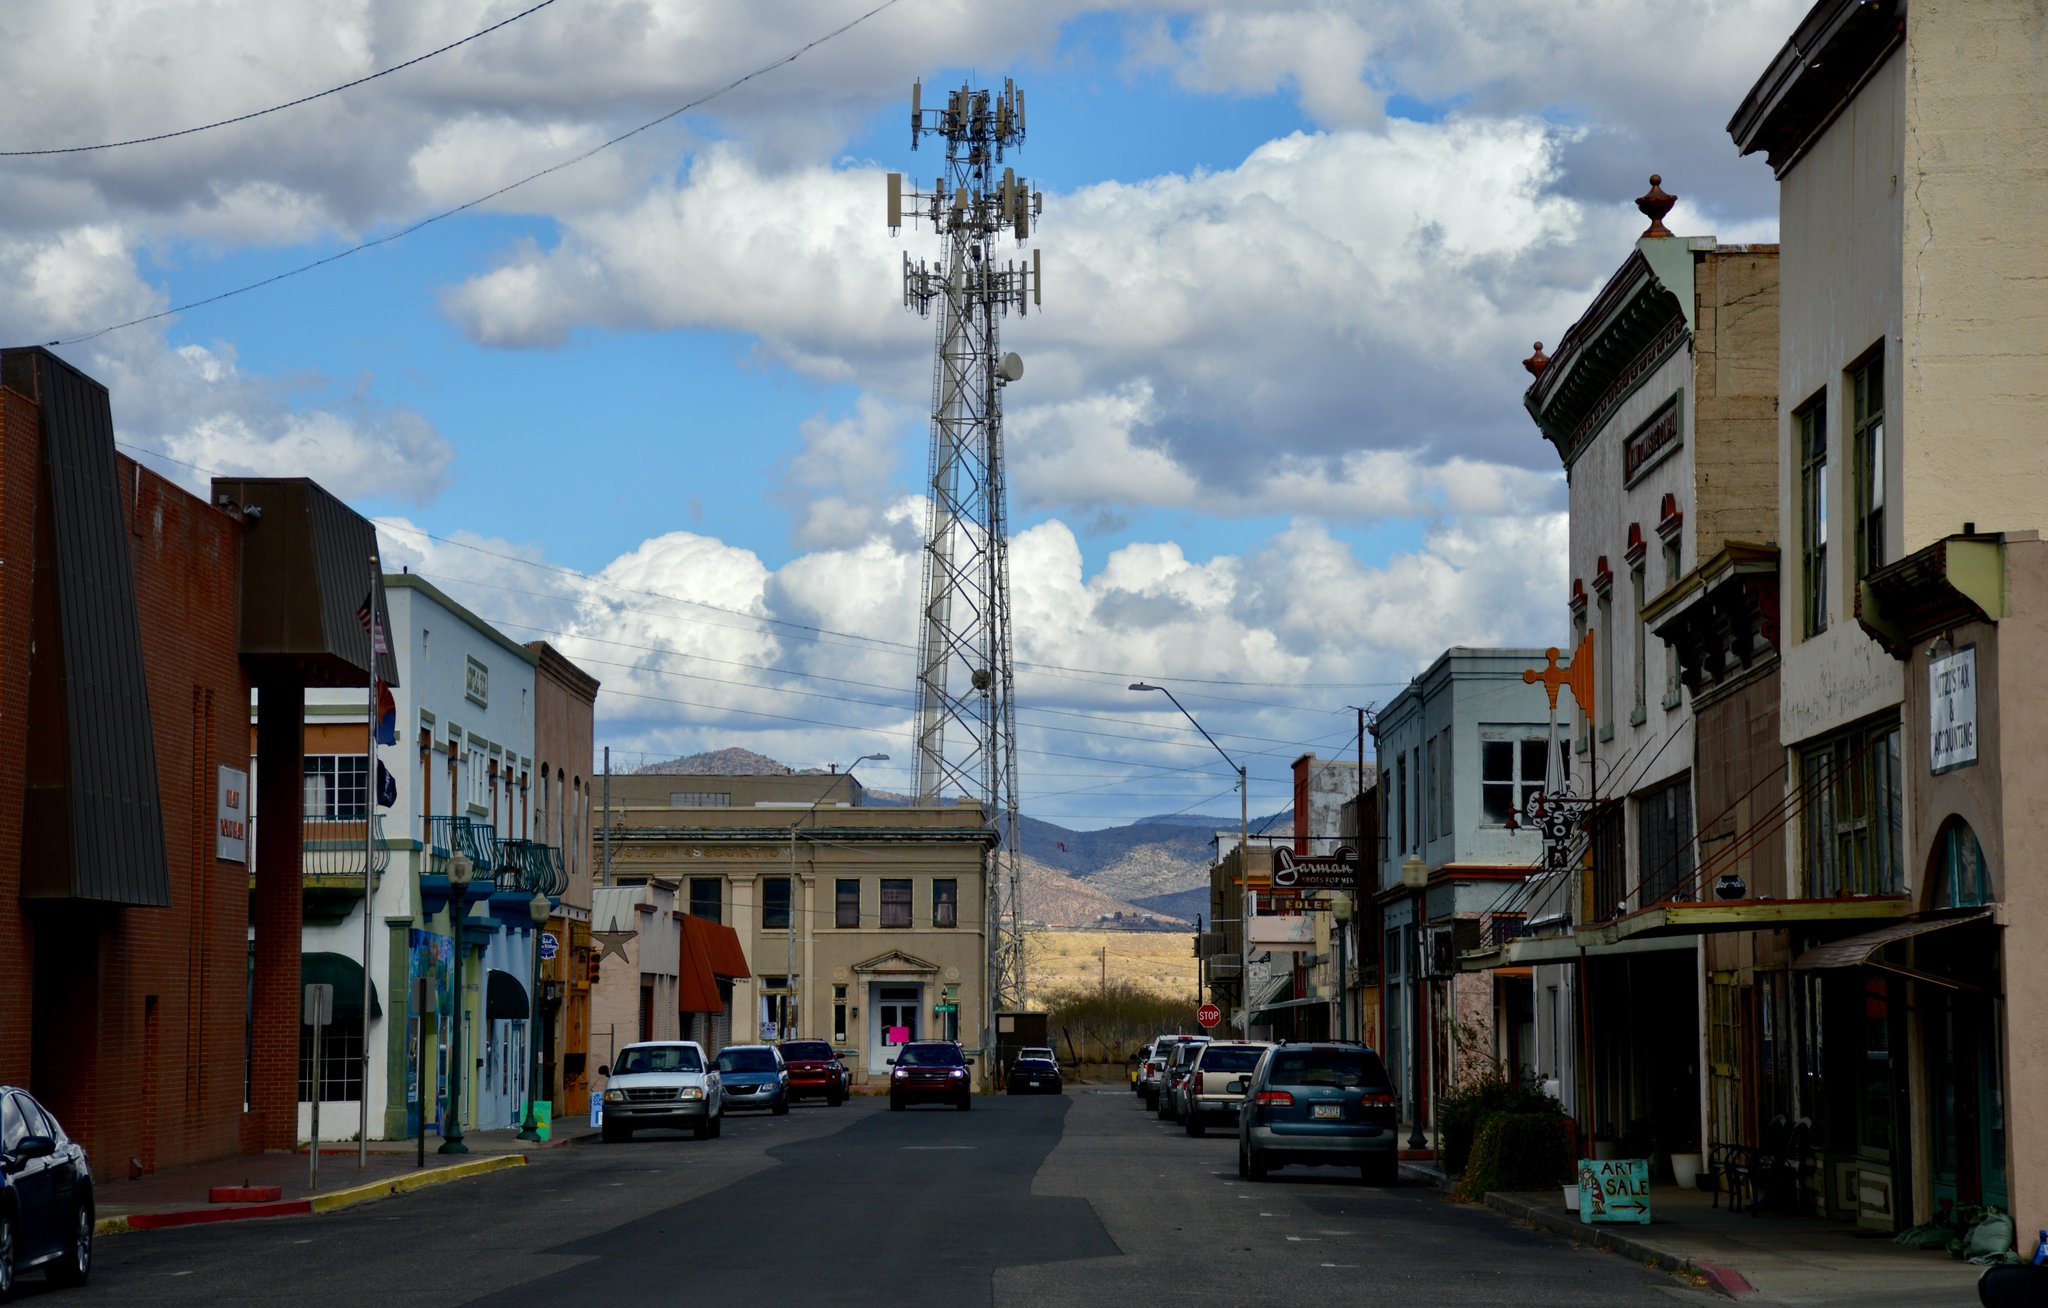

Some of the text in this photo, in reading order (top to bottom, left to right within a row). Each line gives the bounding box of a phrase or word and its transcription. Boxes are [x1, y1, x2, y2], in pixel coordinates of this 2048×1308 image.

[1957, 663, 1970, 690] TAX
[1949, 698, 1954, 723] &
[1934, 721, 1973, 756] ACCOUNTING
[1275, 849, 1354, 885] Jarman
[1341, 876, 1354, 884] MEN
[1199, 1011, 1219, 1021] STOP
[1601, 1162, 1633, 1176] ART
[1606, 1178, 1649, 1196] SALE
